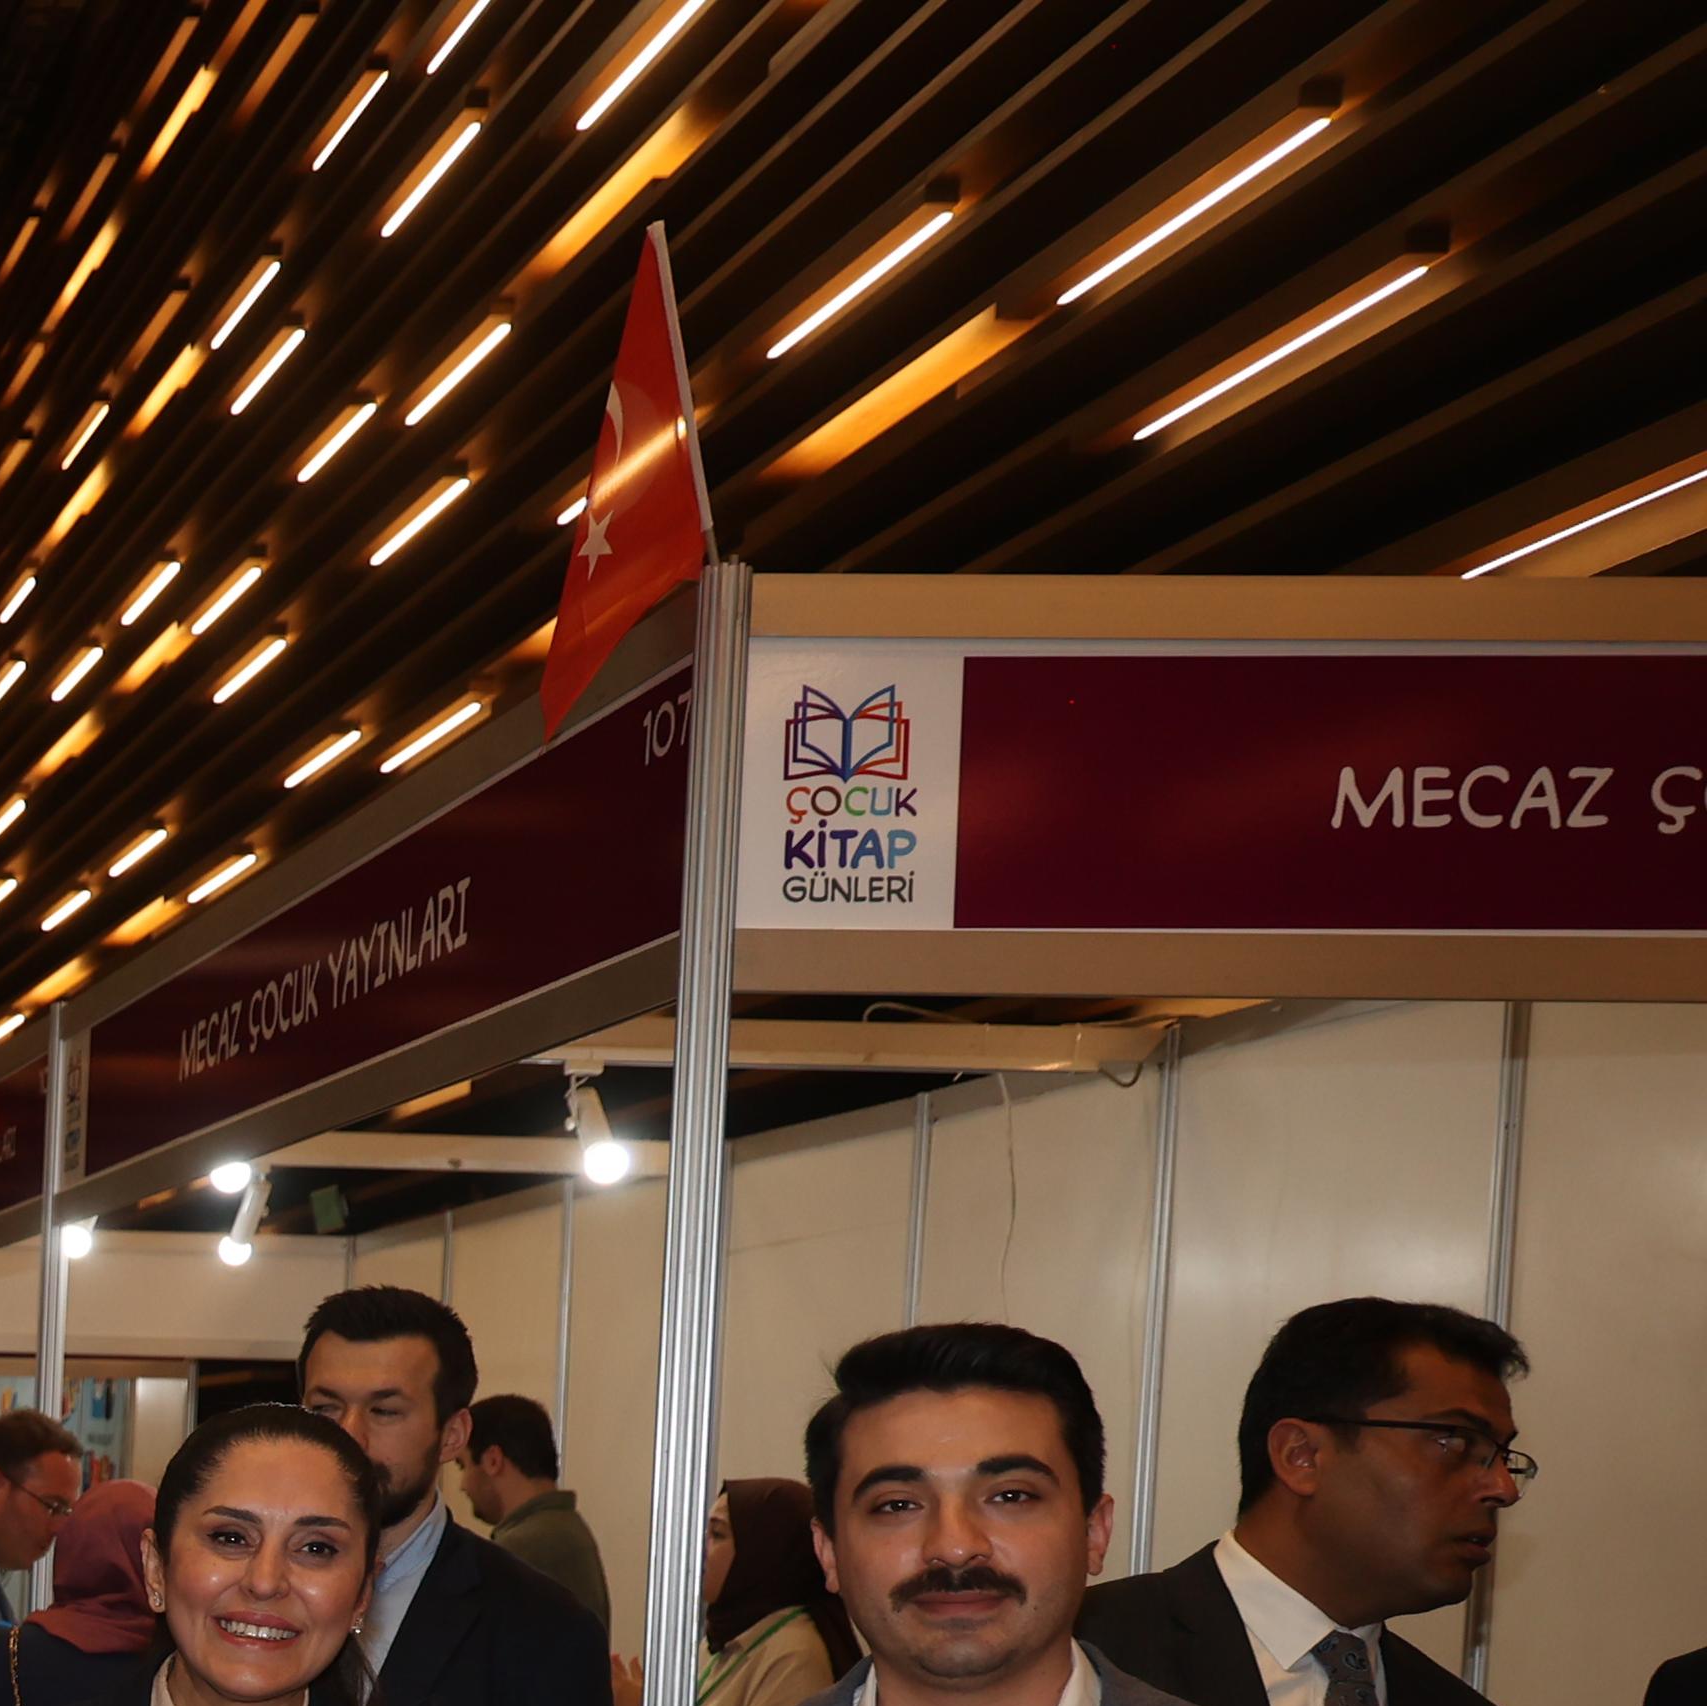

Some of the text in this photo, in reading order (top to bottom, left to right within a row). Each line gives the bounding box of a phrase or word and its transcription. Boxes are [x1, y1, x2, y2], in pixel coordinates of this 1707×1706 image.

[643, 687, 693, 766] 107
[786, 786, 918, 825] ÇOCUK
[1331, 765, 1615, 830] MECAZ
[784, 819, 918, 870] KİTAP
[782, 871, 916, 903] GÜNLERİ
[179, 876, 472, 1083] MECAZ ÇOCUK YAYINLARI
